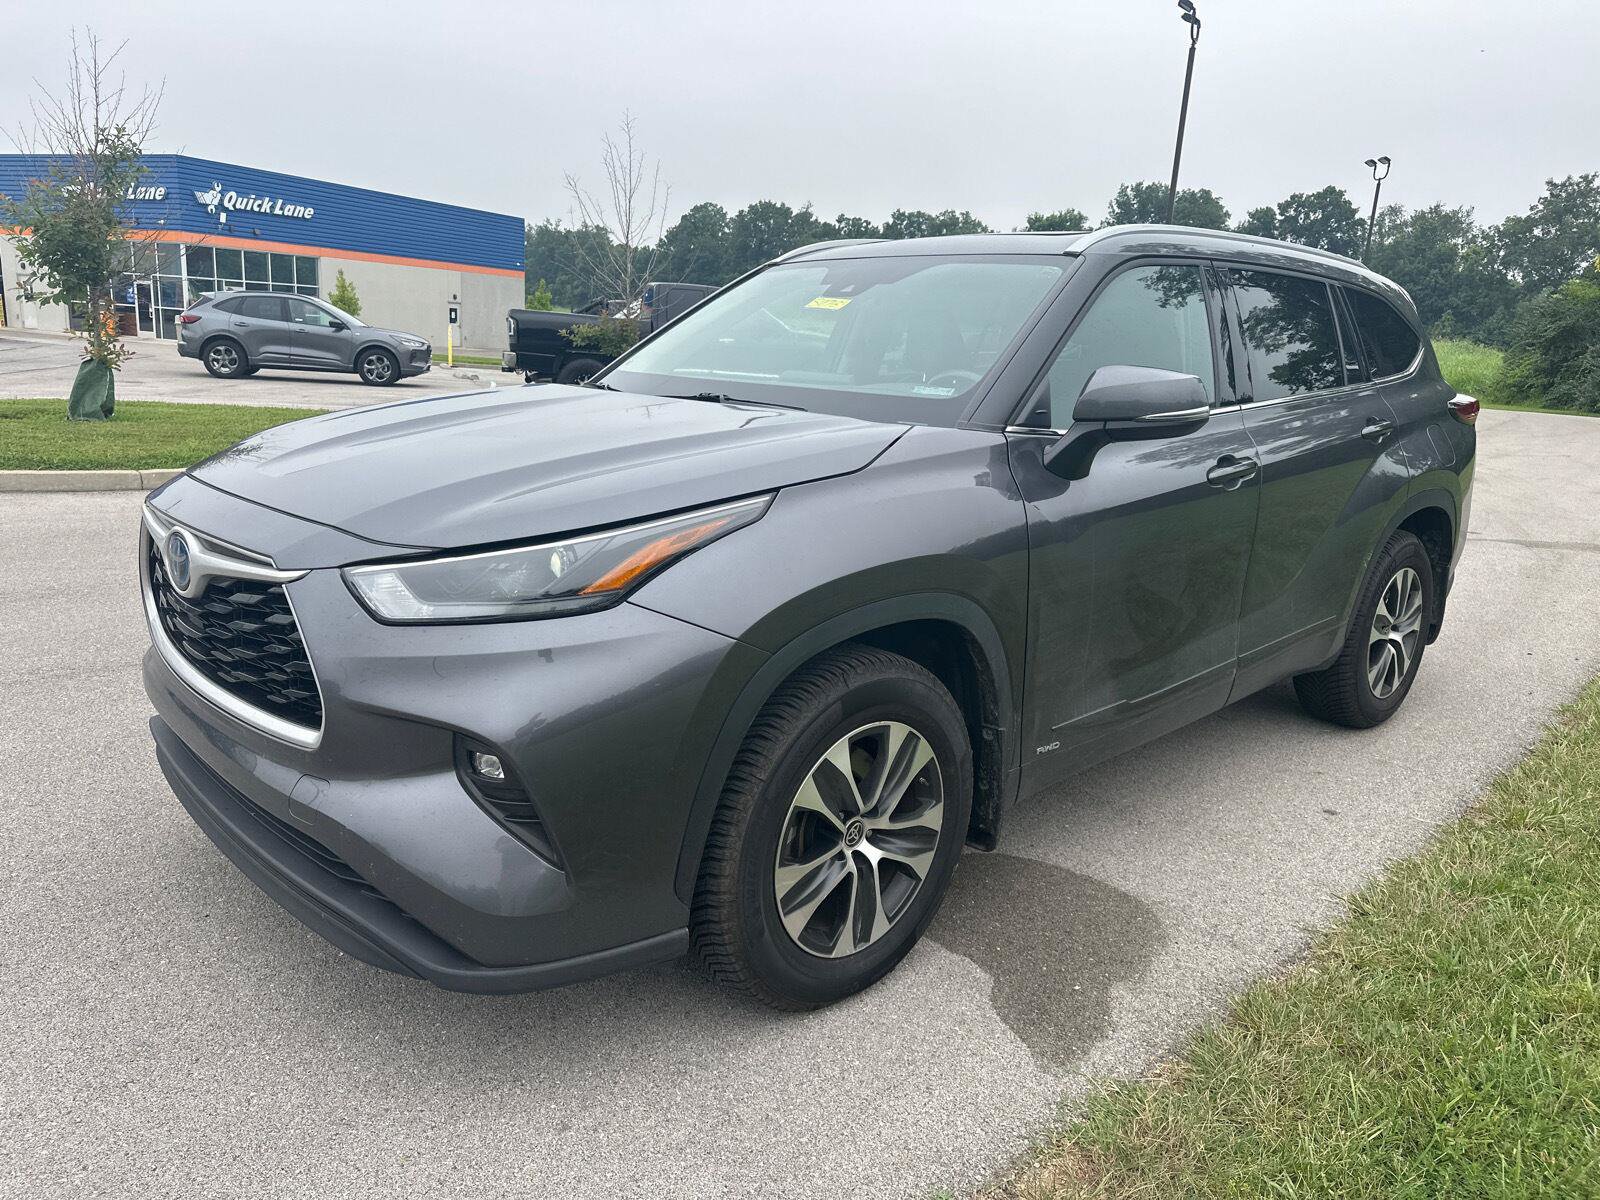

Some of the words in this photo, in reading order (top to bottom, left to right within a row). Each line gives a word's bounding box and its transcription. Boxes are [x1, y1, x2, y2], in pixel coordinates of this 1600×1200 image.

[127, 182, 166, 200] Lane
[223, 191, 274, 213] Quick
[273, 199, 314, 219] Lane
[1036, 741, 1061, 755] AWD
